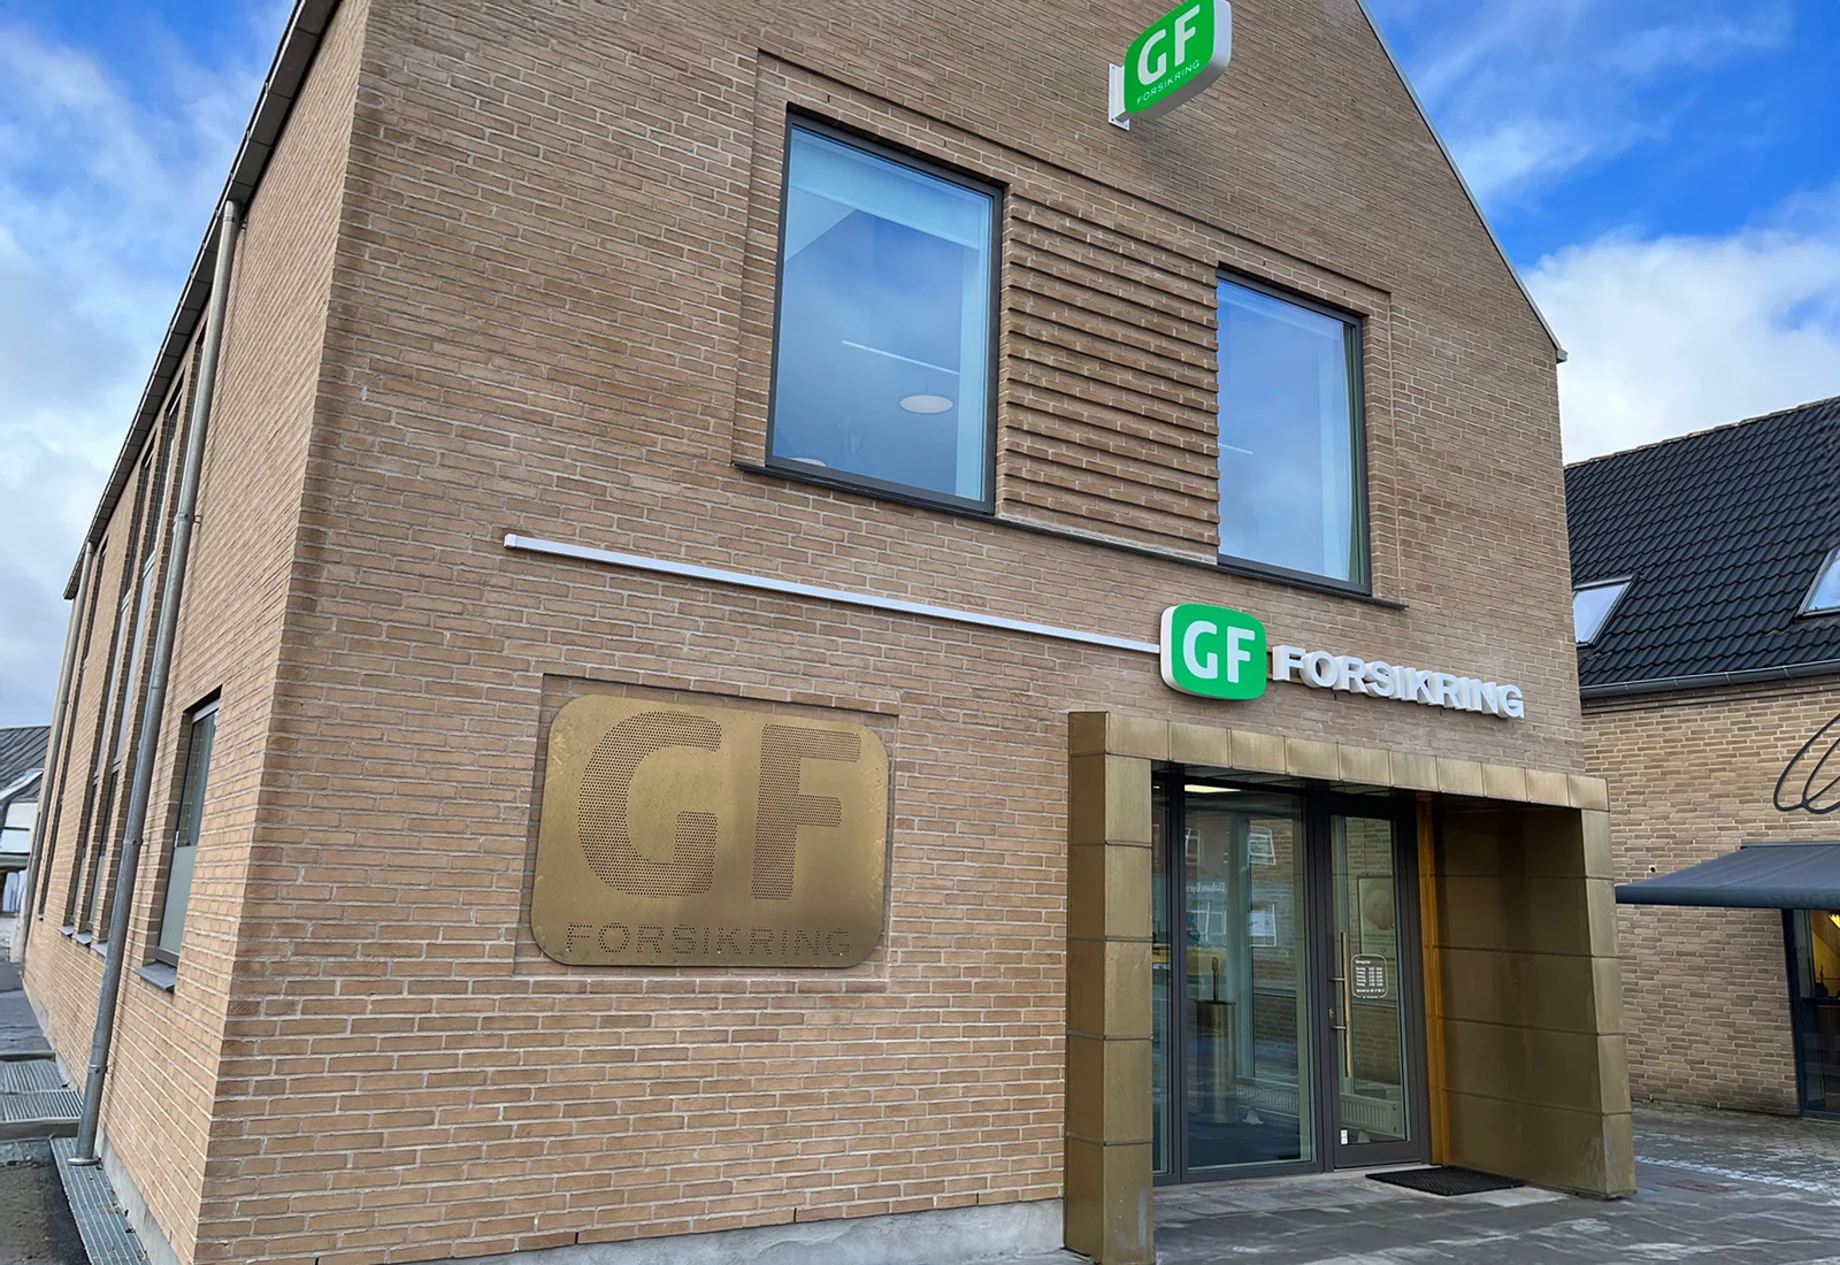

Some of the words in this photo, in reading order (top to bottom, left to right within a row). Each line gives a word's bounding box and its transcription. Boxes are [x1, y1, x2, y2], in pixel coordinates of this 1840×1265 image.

[1136, 59, 1200, 105] FORSIKRING
[1137, 4, 1200, 86] GF
[1182, 620, 1256, 684] GF
[1272, 645, 1525, 719] FORSIKRING
[577, 711, 862, 901] GF
[566, 922, 851, 957] FORSIKRING
